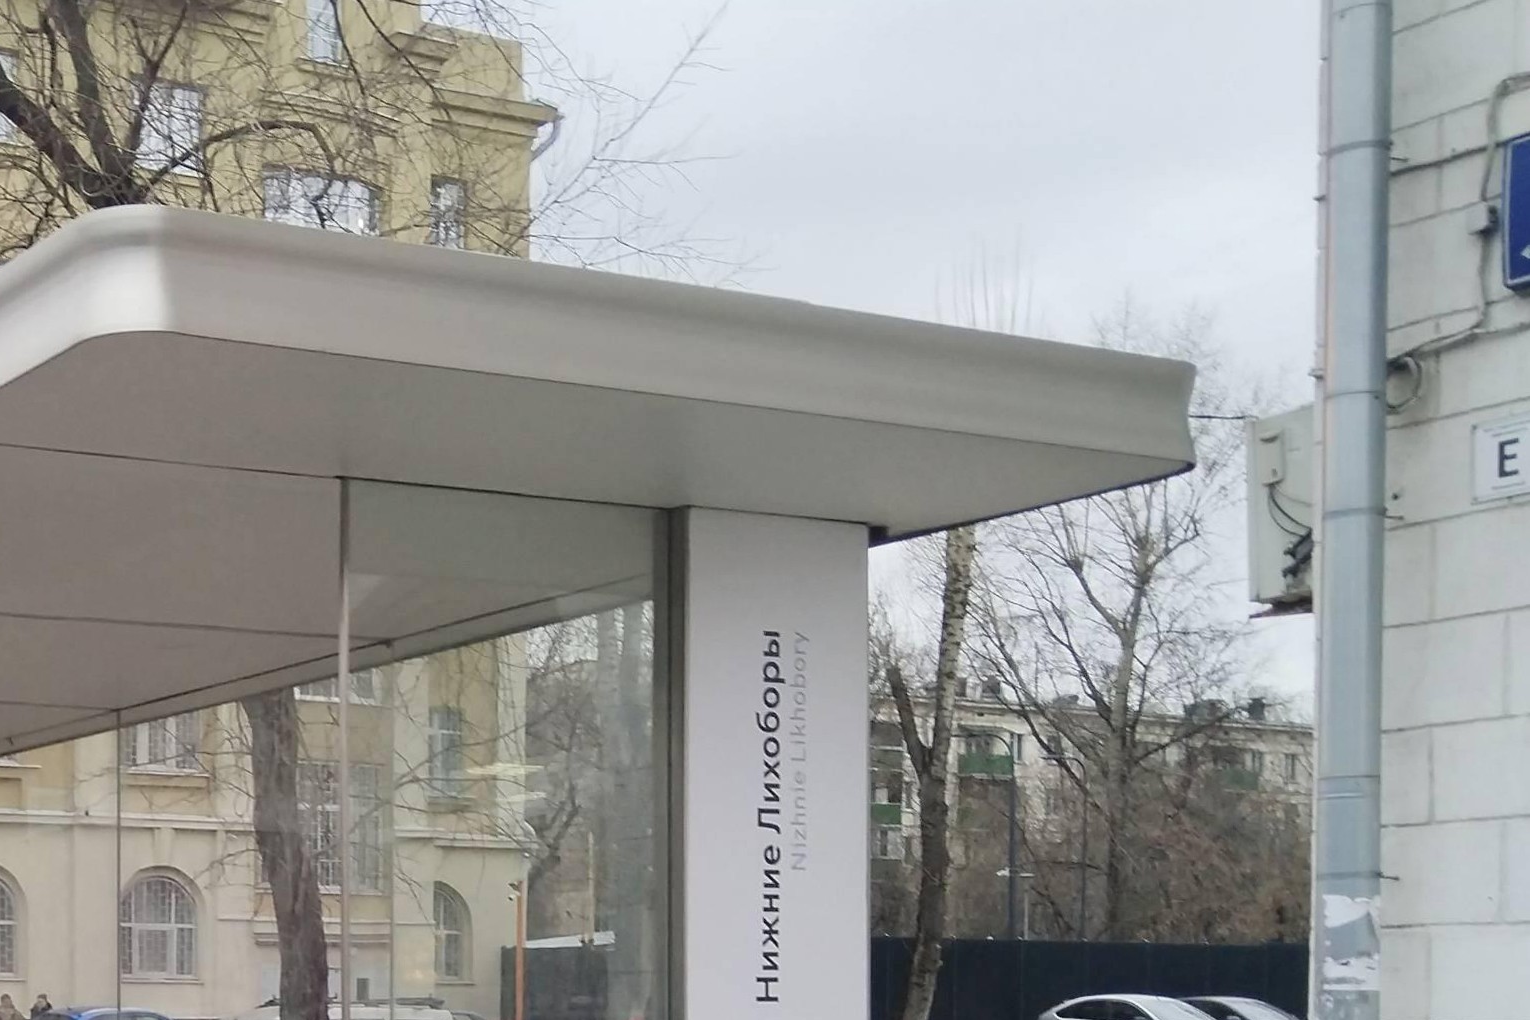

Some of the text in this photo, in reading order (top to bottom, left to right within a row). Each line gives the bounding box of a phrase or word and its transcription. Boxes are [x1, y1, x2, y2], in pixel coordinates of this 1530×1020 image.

[755, 630, 786, 1003] Нижние Лихоборы
[791, 631, 810, 872] Nizhnie Likhobory
